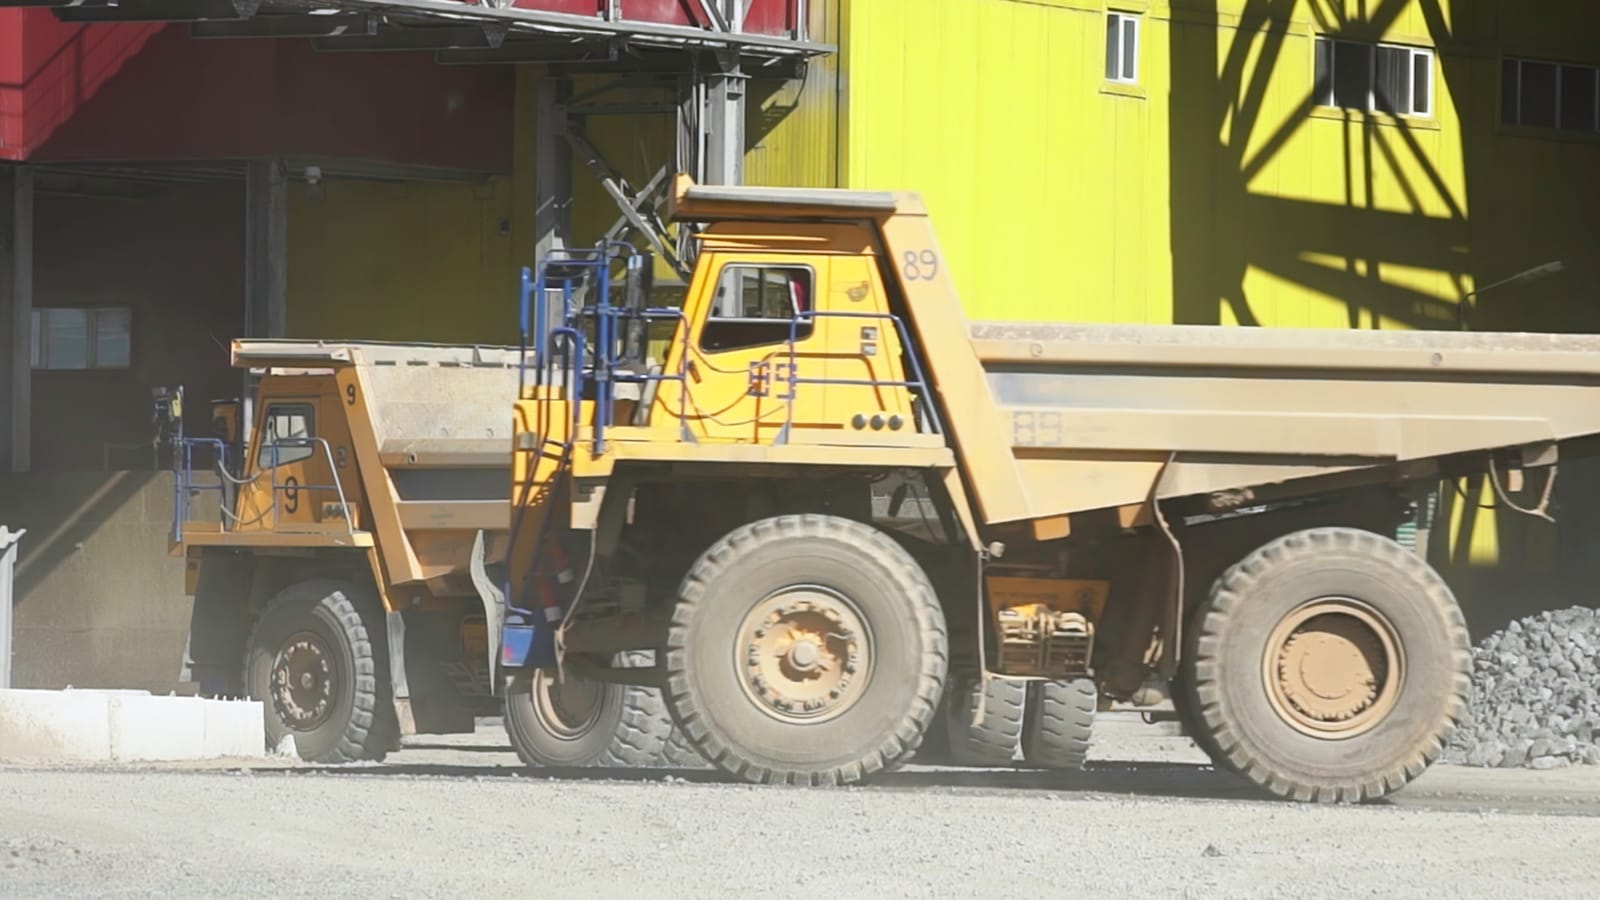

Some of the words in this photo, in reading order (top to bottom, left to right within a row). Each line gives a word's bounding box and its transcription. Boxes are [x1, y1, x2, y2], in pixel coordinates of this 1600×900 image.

[903, 249, 938, 281] 89
[346, 383, 356, 405] 9
[748, 361, 796, 399] 89
[284, 475, 299, 514] 9
